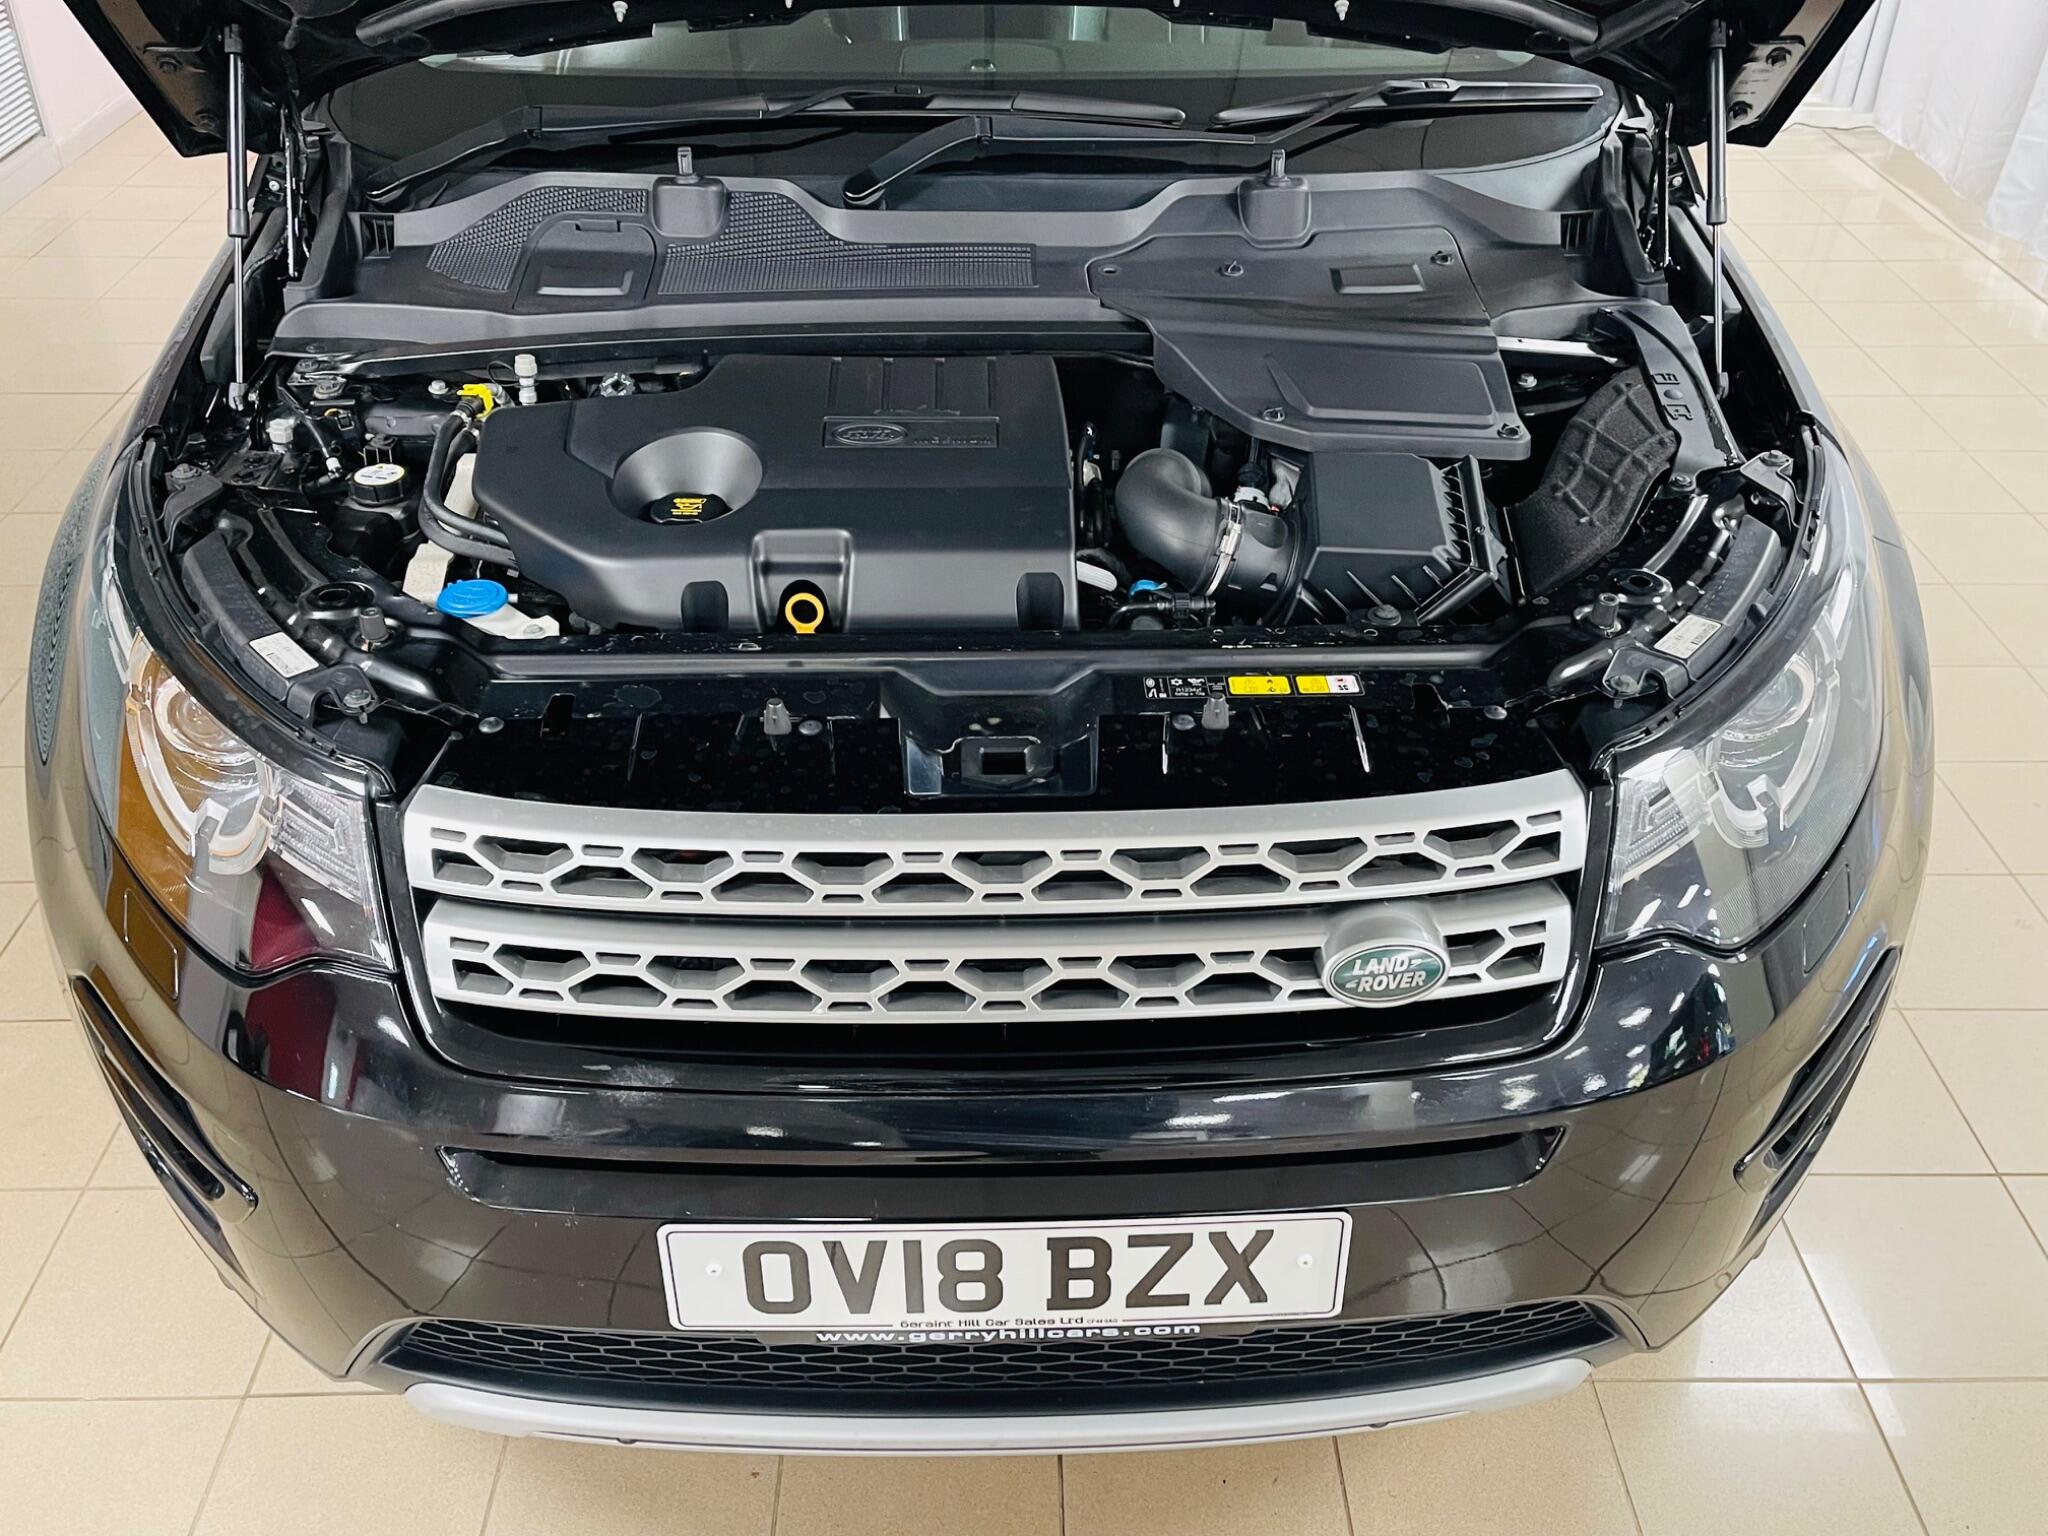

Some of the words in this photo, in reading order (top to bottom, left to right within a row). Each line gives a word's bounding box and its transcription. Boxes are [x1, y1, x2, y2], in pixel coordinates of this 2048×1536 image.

[1352, 956, 1409, 975] LAND
[1357, 971, 1426, 993] ROVER
[742, 1239, 1003, 1314] OV18
[1045, 1229, 1274, 1310] BZX
[958, 1319, 980, 1327] Hill
[816, 1325, 1200, 1342] www.gerryhillcars.com
